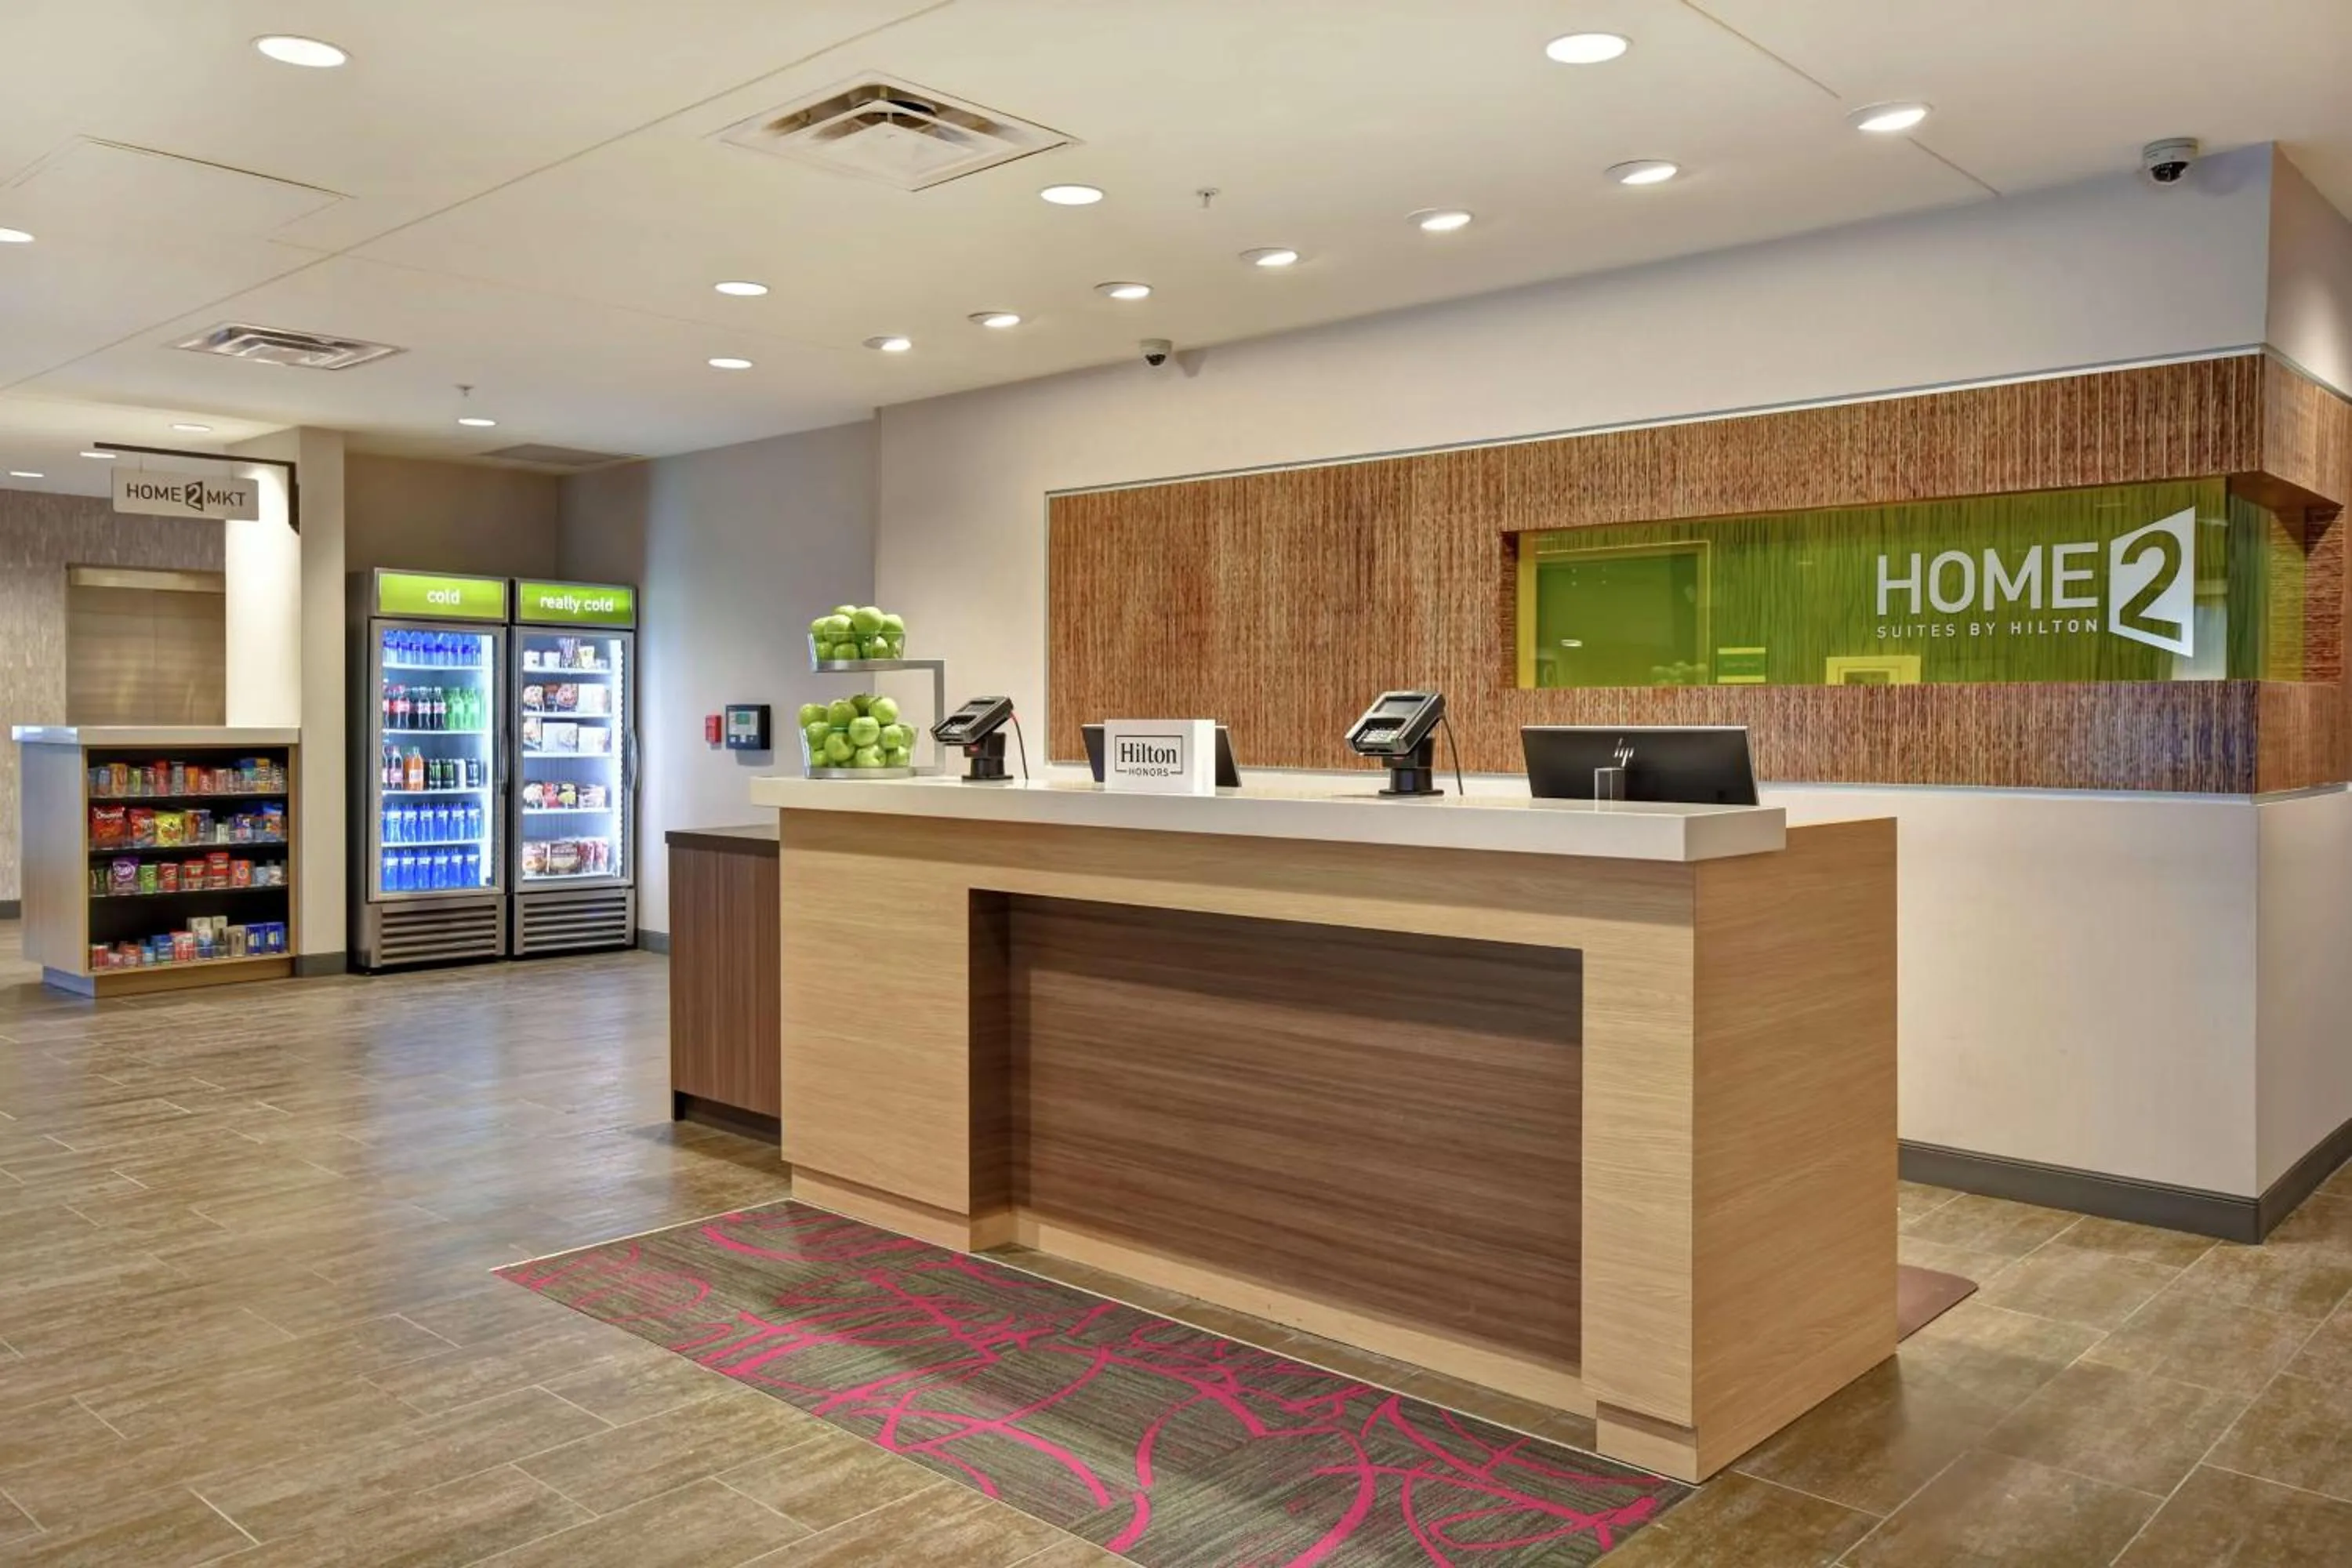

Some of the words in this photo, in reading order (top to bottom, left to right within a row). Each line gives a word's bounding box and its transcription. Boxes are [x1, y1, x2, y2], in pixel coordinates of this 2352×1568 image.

[206, 488, 247, 507] MKT
[426, 588, 462, 604] cold
[539, 594, 581, 615] really
[583, 597, 615, 612] cold
[1877, 623, 1955, 639] SUITES
[1969, 622, 1996, 637] BY
[2010, 619, 2098, 635] HILTON
[1120, 742, 1178, 764] Hilton
[1128, 768, 1169, 777] HONORS
